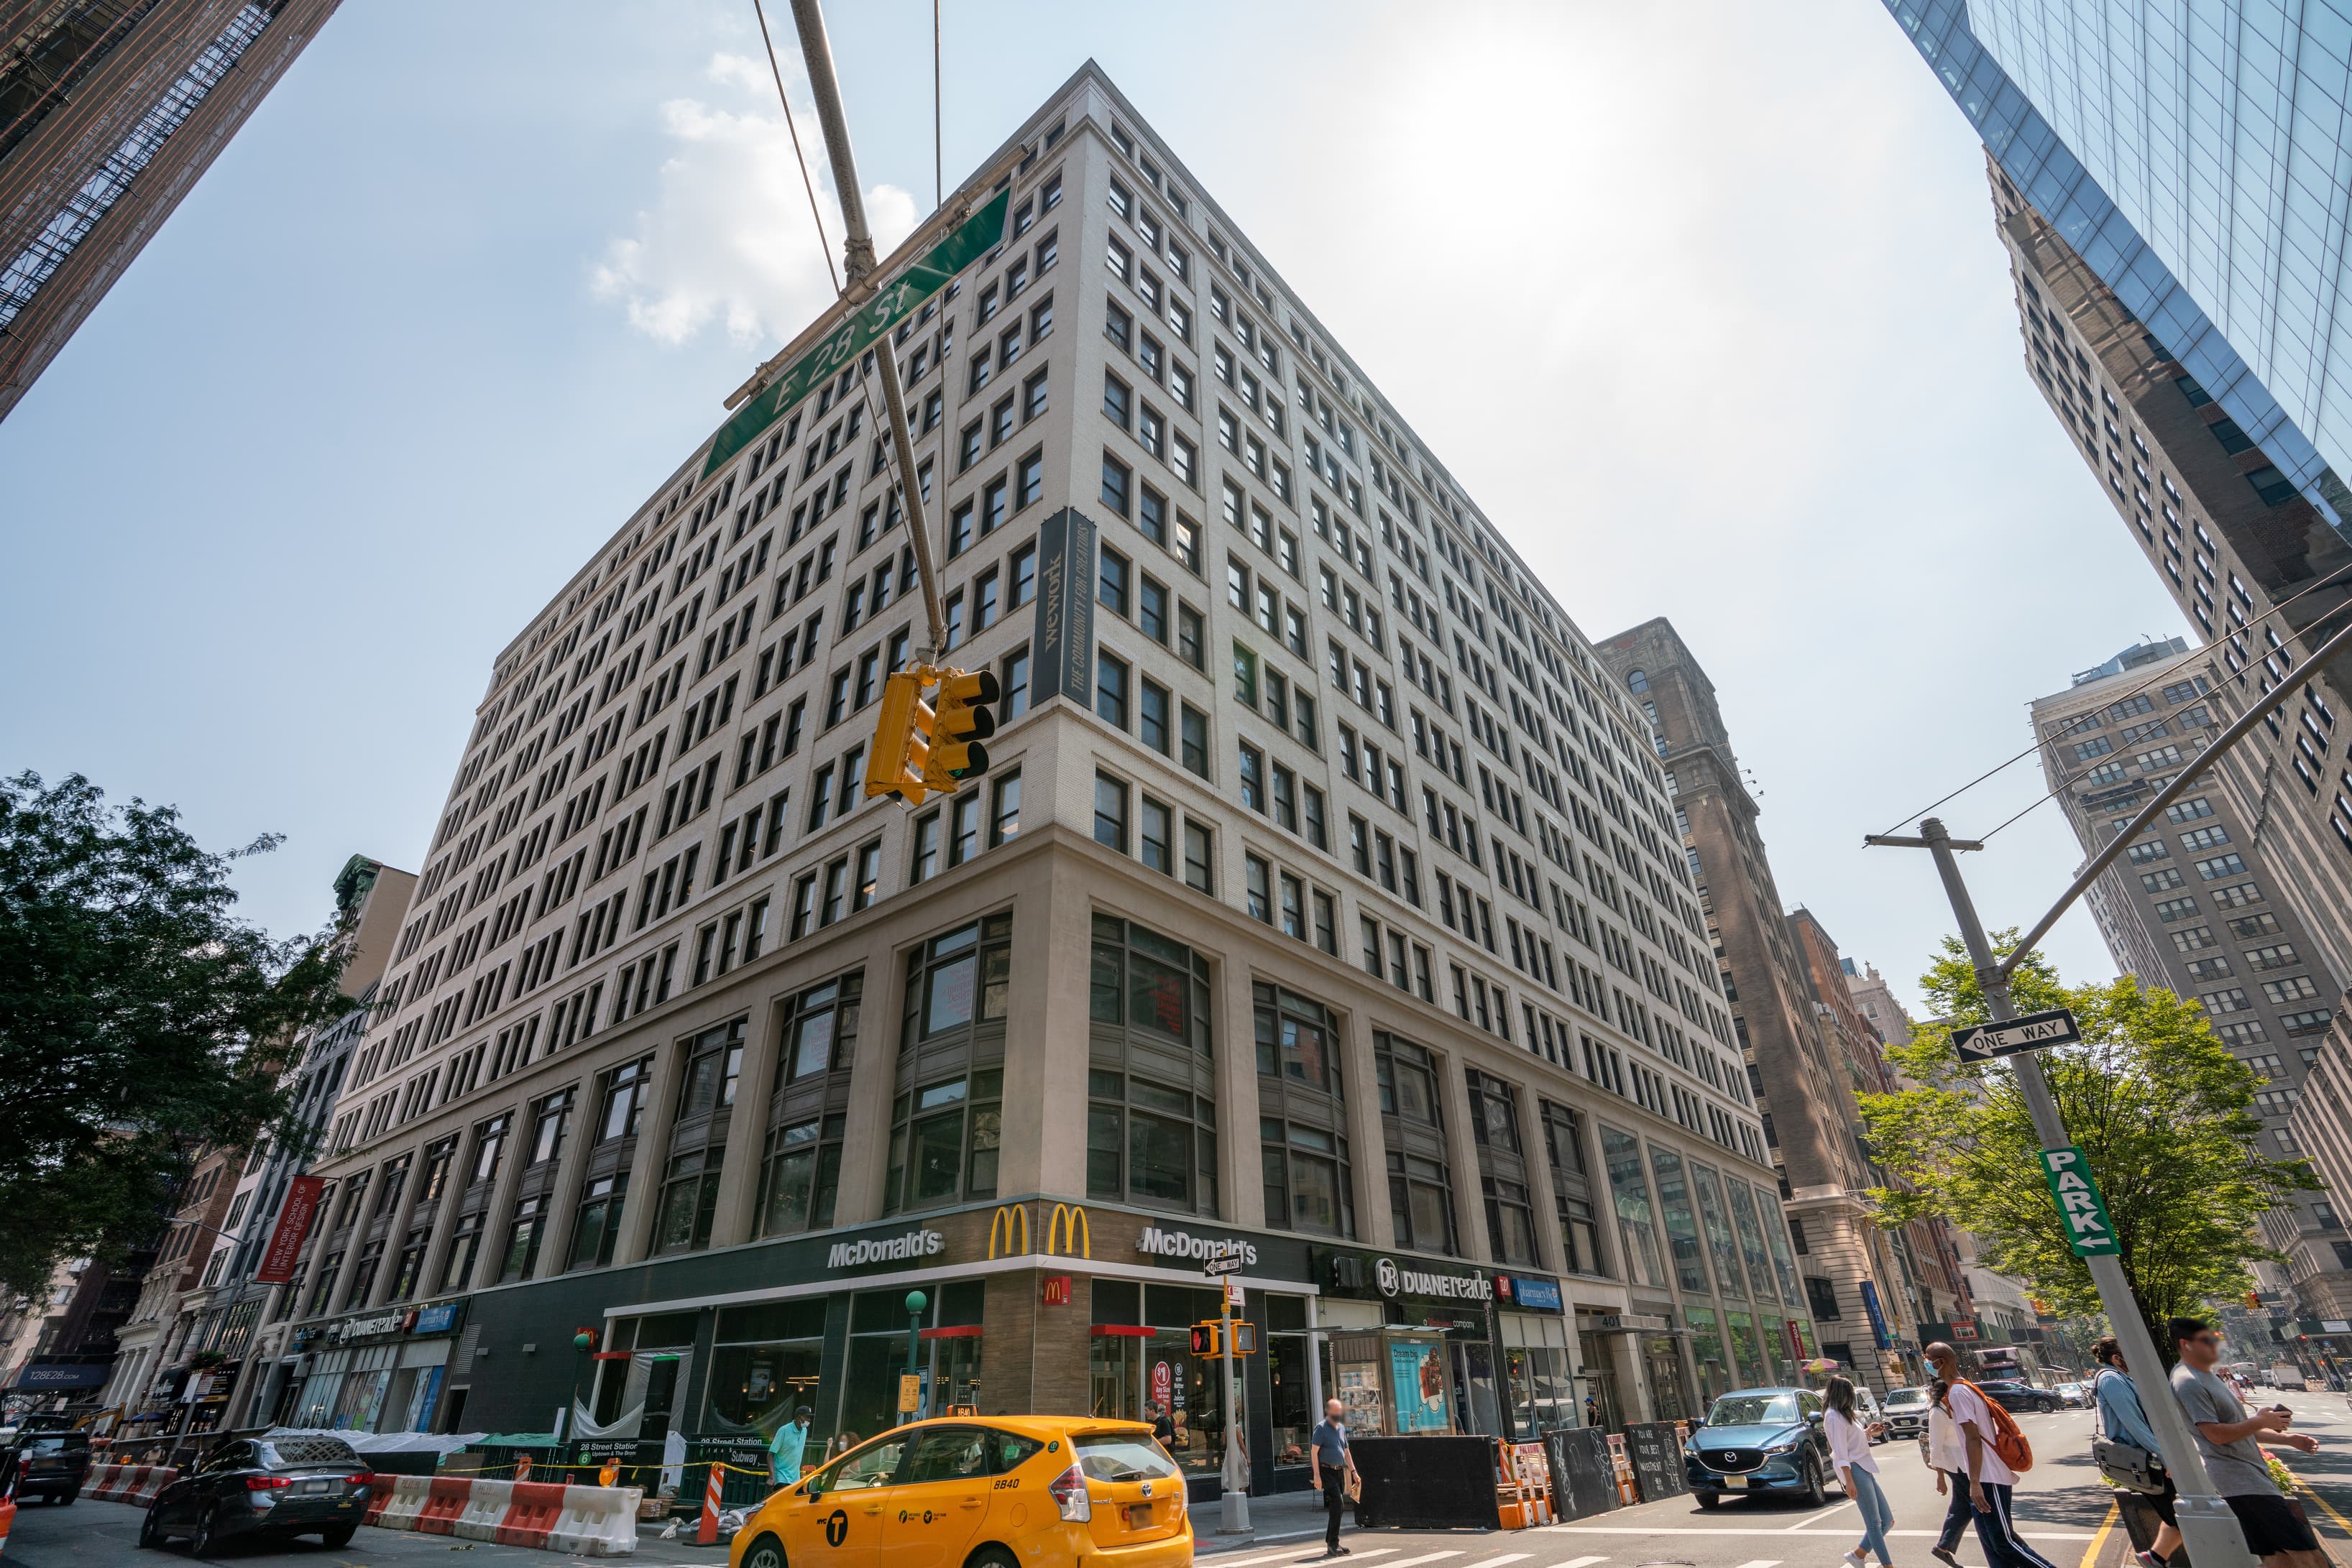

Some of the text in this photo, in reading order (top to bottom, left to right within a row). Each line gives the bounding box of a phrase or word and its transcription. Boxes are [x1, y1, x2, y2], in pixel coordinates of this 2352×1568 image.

[773, 279, 911, 415] E 28 St
[1043, 551, 1061, 653] wework
[1071, 522, 1090, 692] THE COMMUNITY FOR CREATORS
[1973, 1032, 2008, 1050] ONE
[2021, 1021, 2057, 1041] WAY
[2046, 1151, 2106, 1233] PARK
[271, 1250, 283, 1266] NEW
[279, 1226, 291, 1247] YORK
[288, 1196, 304, 1225] SCHOOL
[298, 1184, 307, 1194] OF
[280, 1204, 309, 1268] INTERIOR DESIGN
[827, 1230, 942, 1268] McDonald's
[1141, 1227, 1257, 1265] McDonald's
[1210, 1260, 1238, 1271] ONE WAY
[1453, 1319, 1474, 1331] company
[1602, 1315, 1620, 1327] 401
[1393, 1349, 1410, 1357] Dream
[1157, 1367, 1166, 1382] $1
[1639, 1444, 1660, 1455] YOUR BEST
[582, 1454, 588, 1463] 6
[731, 1451, 758, 1465] Subway
[1640, 1461, 1662, 1472] INVESTMENT
[994, 1479, 1019, 1490] 8B40
